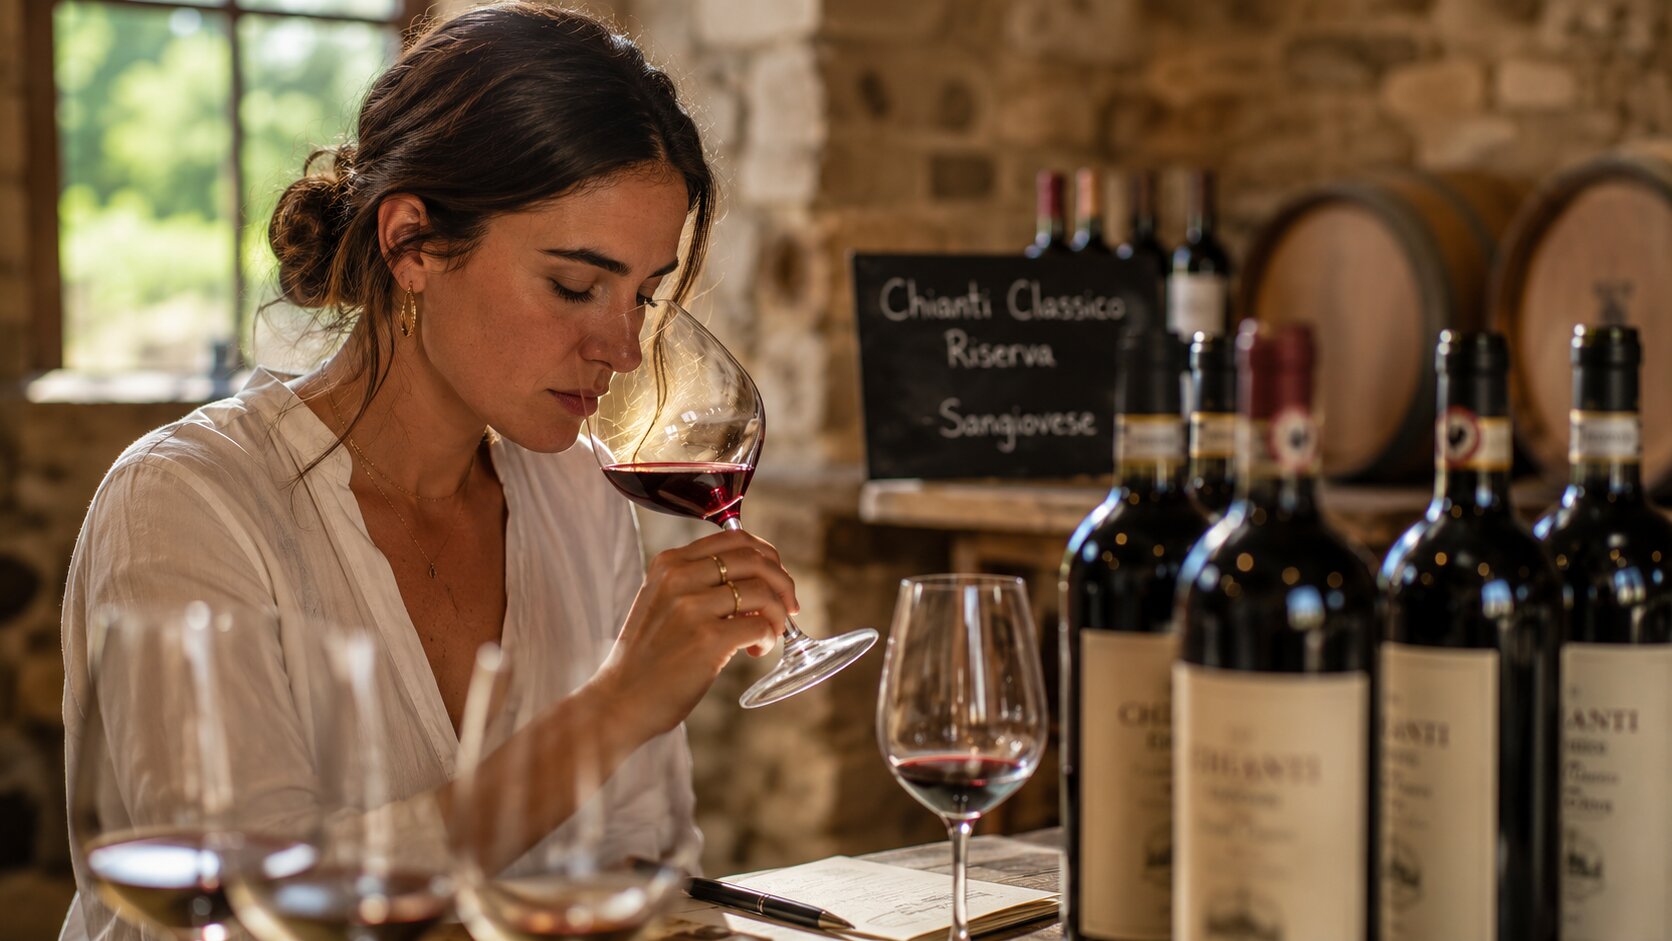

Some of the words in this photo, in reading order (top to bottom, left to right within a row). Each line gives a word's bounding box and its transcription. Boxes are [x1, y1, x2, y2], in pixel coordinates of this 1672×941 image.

[879, 277, 992, 321] Chianti
[1007, 279, 1127, 321] Classico
[944, 329, 1056, 369] Riserva
[938, 397, 1098, 453] Sangiovese
[1565, 708, 1639, 733] ANTI
